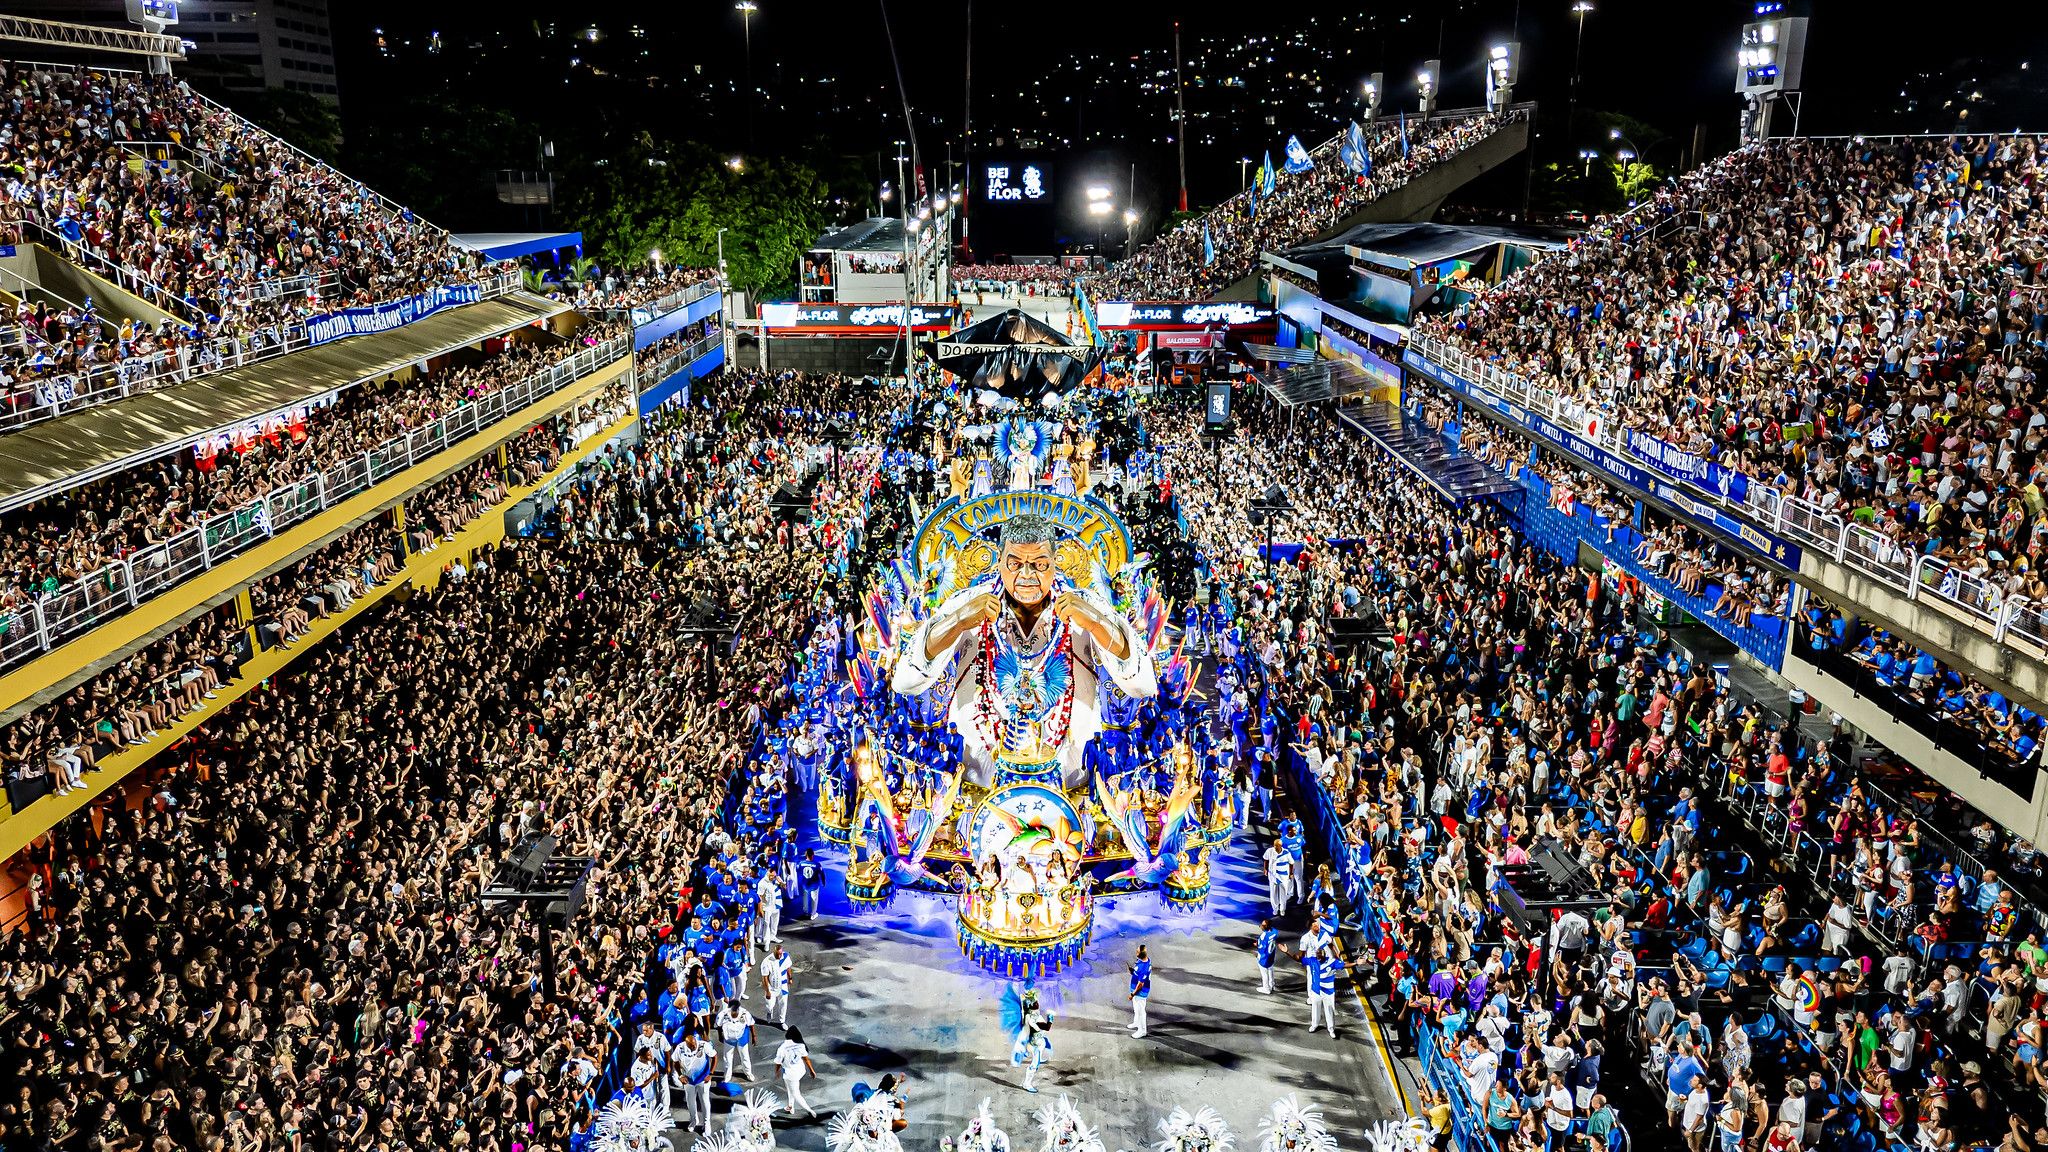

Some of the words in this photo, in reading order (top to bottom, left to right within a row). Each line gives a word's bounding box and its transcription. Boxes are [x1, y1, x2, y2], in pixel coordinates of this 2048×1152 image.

[988, 168, 1008, 178] BEI
[988, 179, 1007, 189] JA-
[988, 188, 1021, 200] FLOR
[308, 315, 352, 344] TORCIDA
[352, 309, 402, 332] SOBERANOS
[942, 344, 961, 356] DO
[1541, 422, 1562, 443] PORTELA
[1570, 438, 1594, 461] PORTELA
[1603, 456, 1631, 480] PORTELA
[1663, 446, 1708, 479] SOBERAS
[958, 496, 1094, 531] COMUNIDADE
[1743, 527, 1750, 538] DE
[1751, 532, 1767, 549] AMAR
